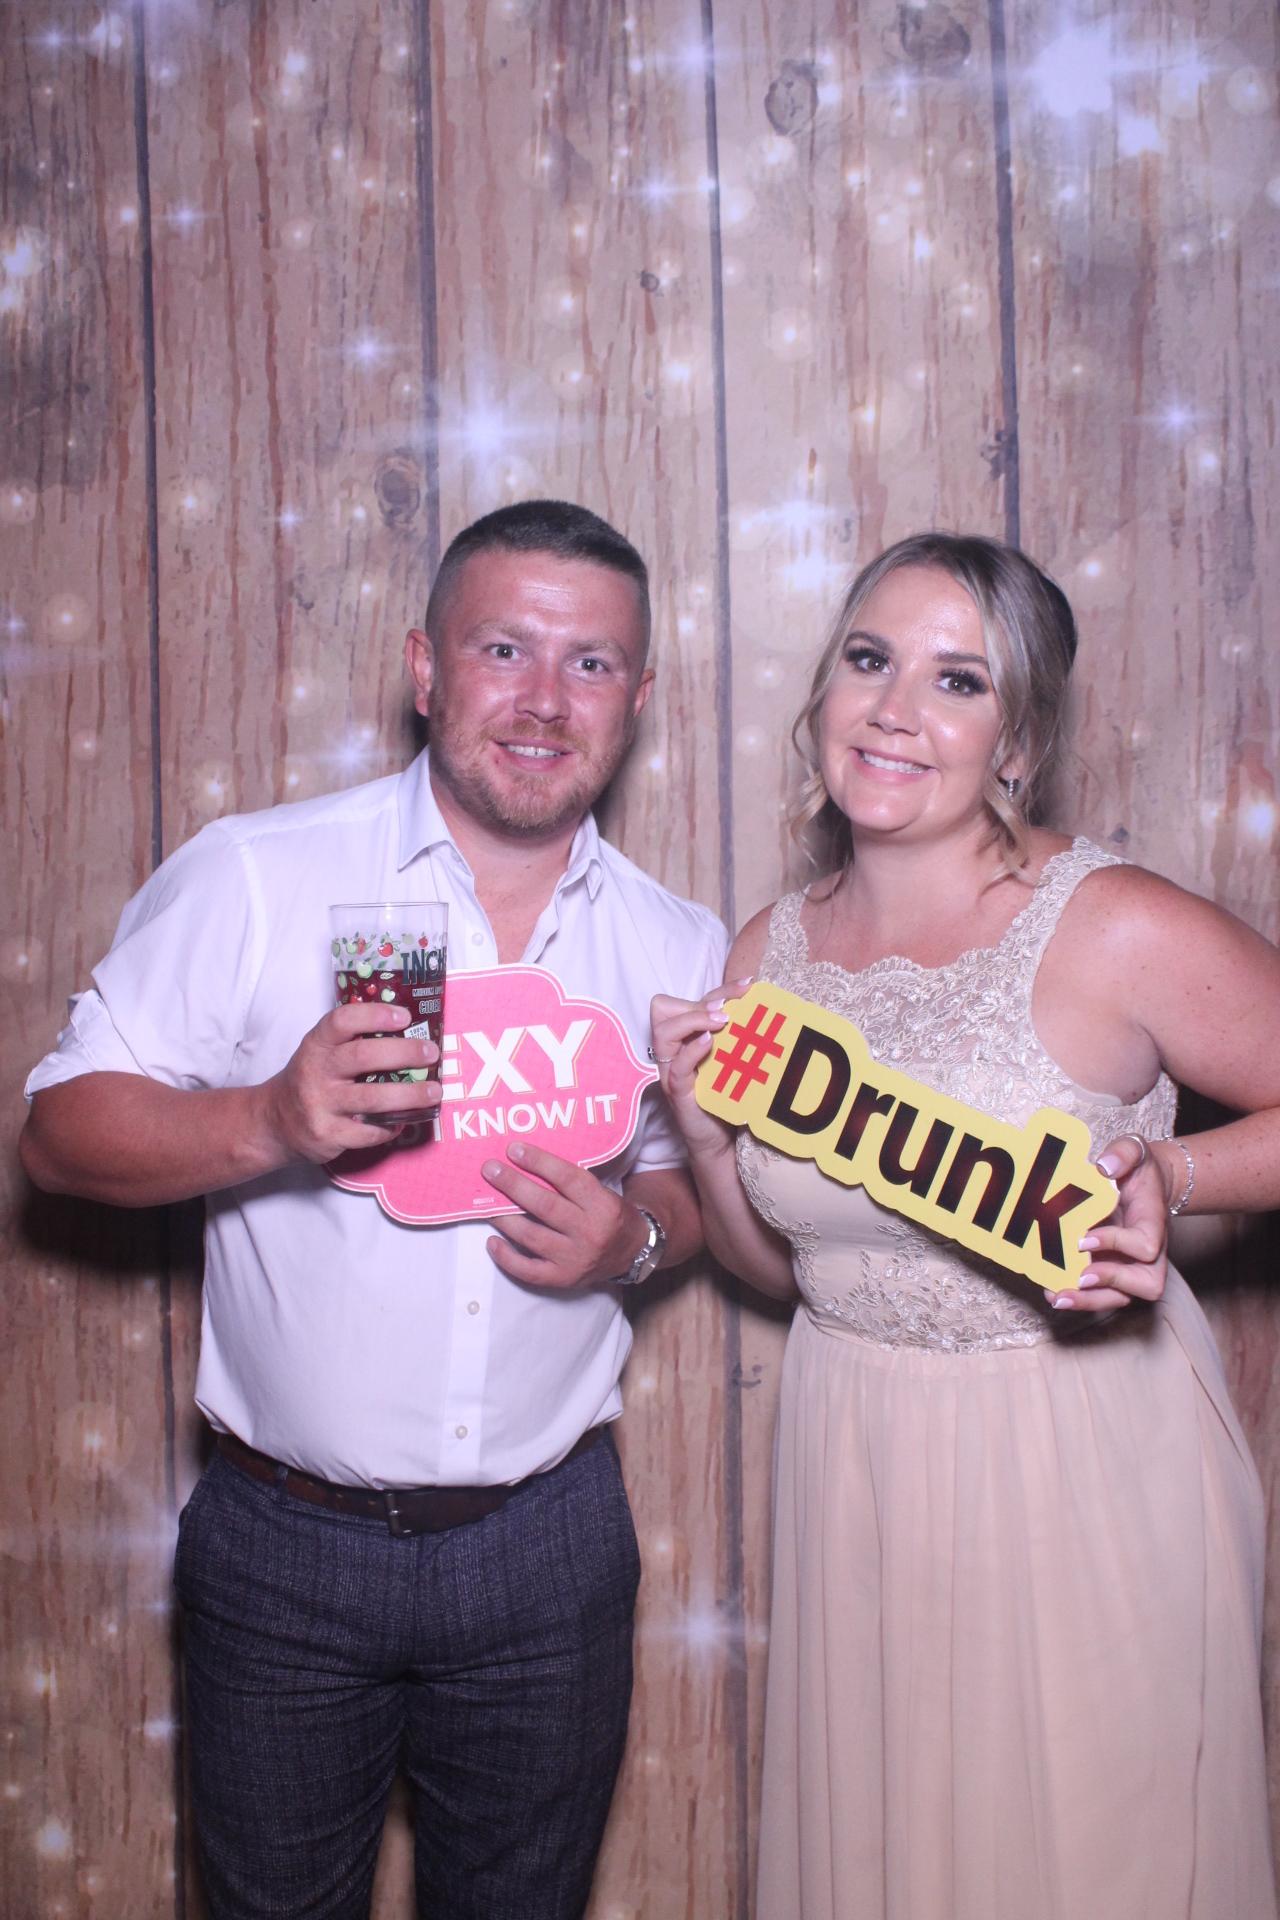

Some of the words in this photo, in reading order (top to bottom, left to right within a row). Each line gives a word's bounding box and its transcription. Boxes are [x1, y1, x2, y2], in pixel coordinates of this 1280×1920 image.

[419, 999, 441, 1014] CIDE
[441, 1019, 596, 1101] EXY
[452, 1098, 577, 1140] KNOW
[585, 1093, 619, 1125] IT
[710, 1003, 1094, 1271] #Drunk
